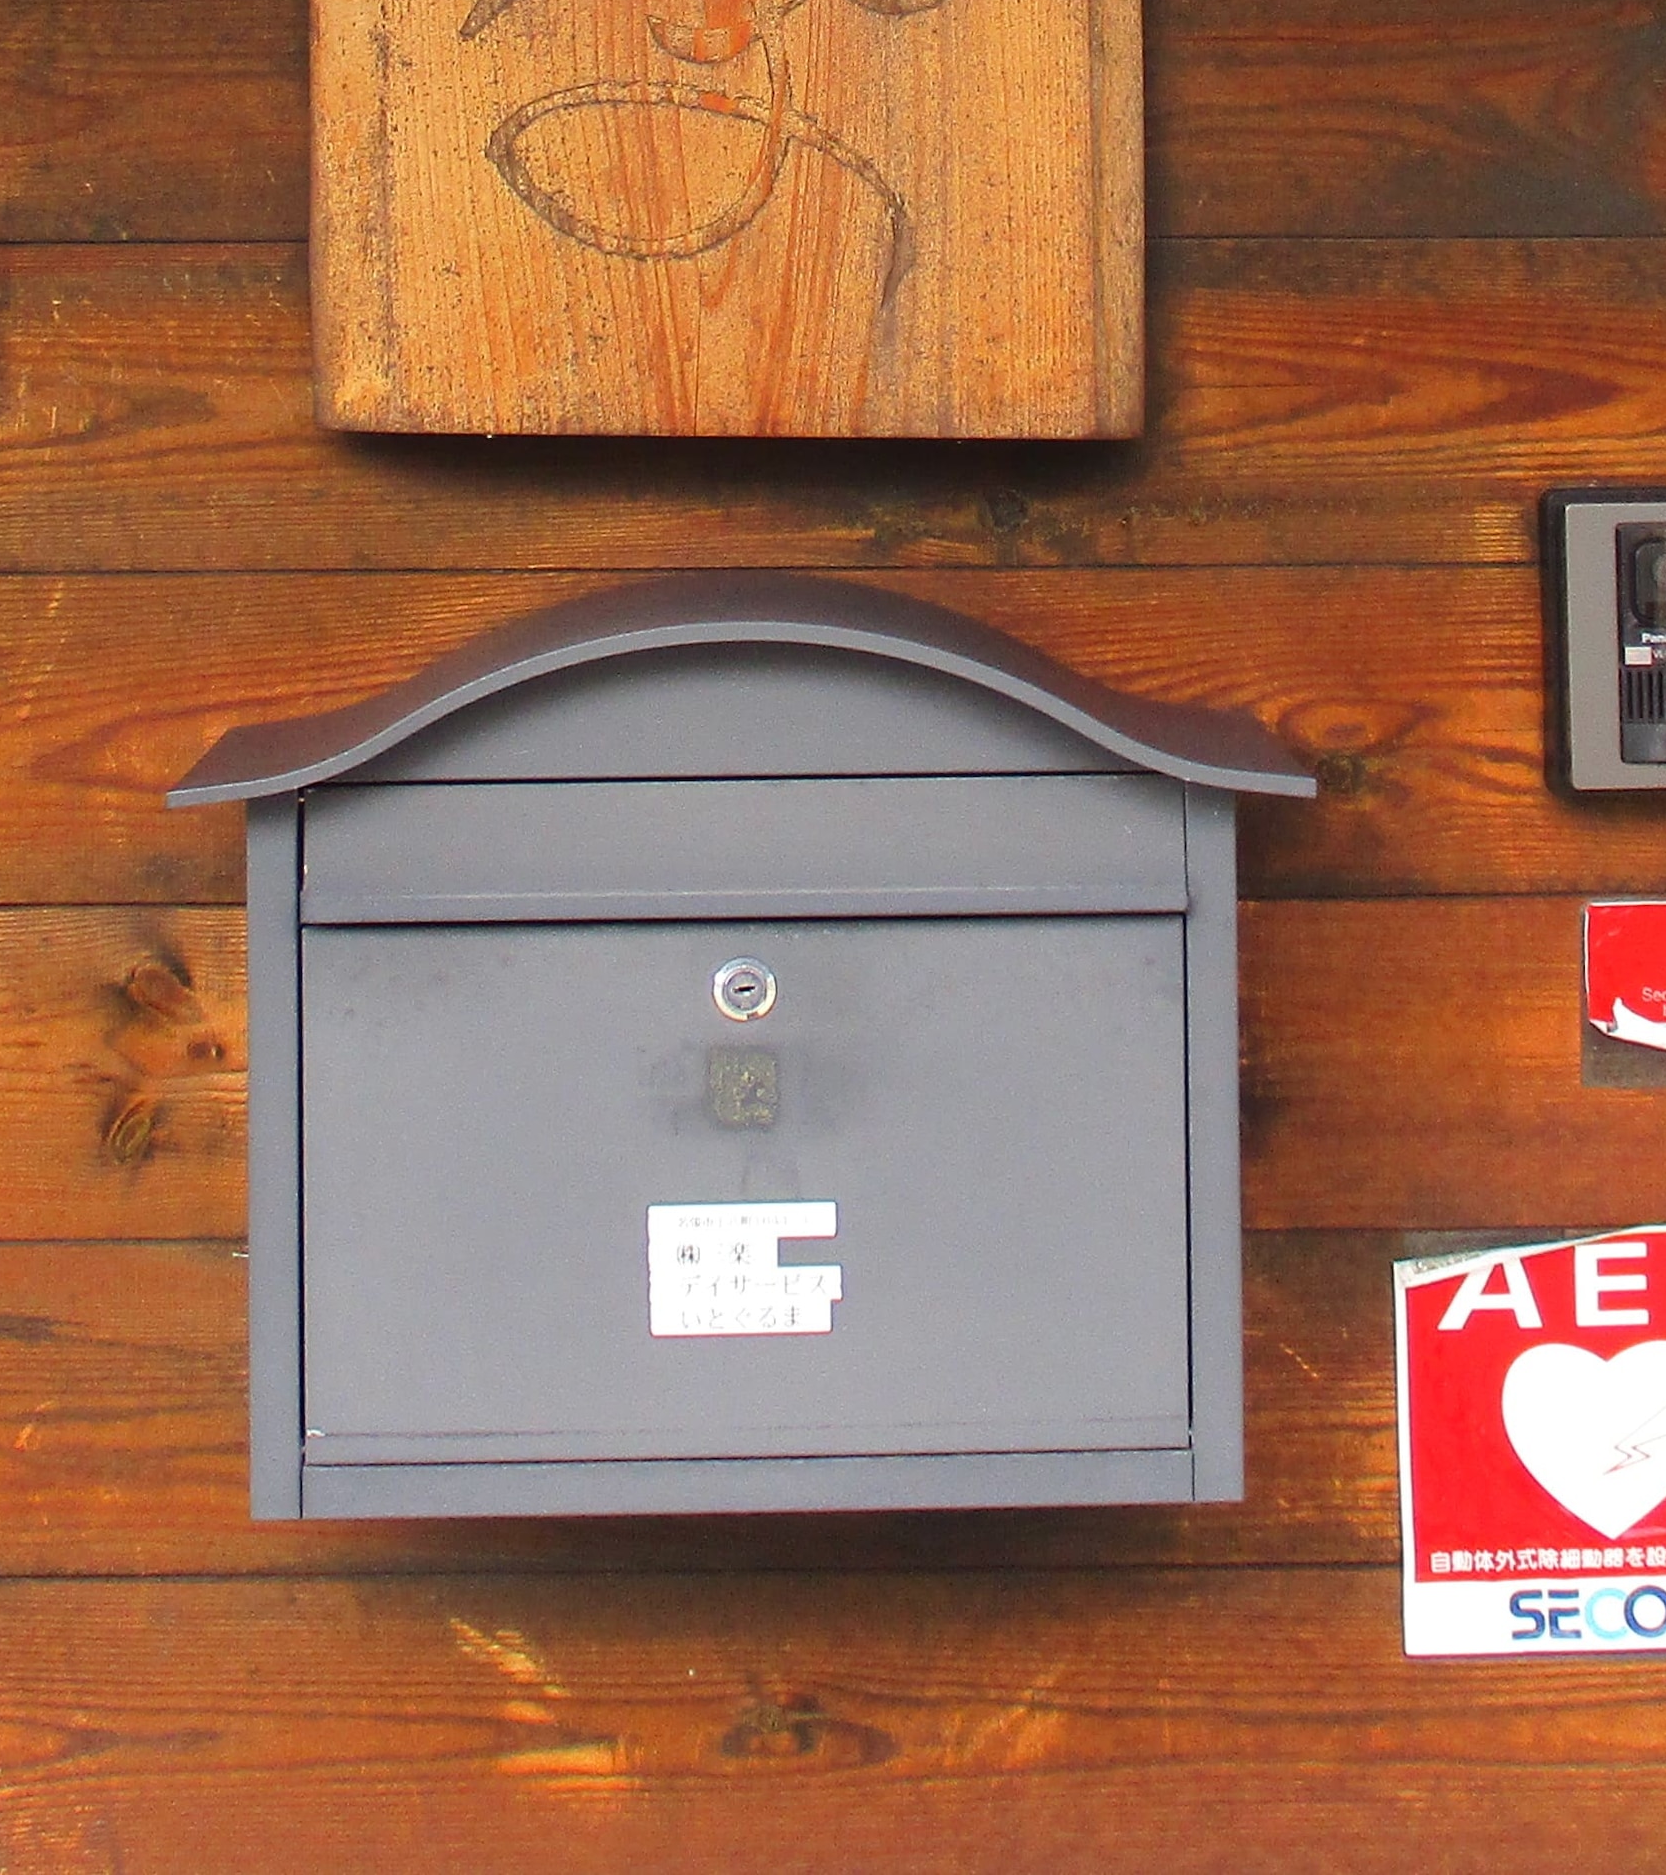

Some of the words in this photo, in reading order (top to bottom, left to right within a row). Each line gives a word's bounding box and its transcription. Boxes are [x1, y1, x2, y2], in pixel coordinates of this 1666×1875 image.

[681, 1273, 827, 1298] デイサービス
[681, 1305, 801, 1329] いとぐるま
